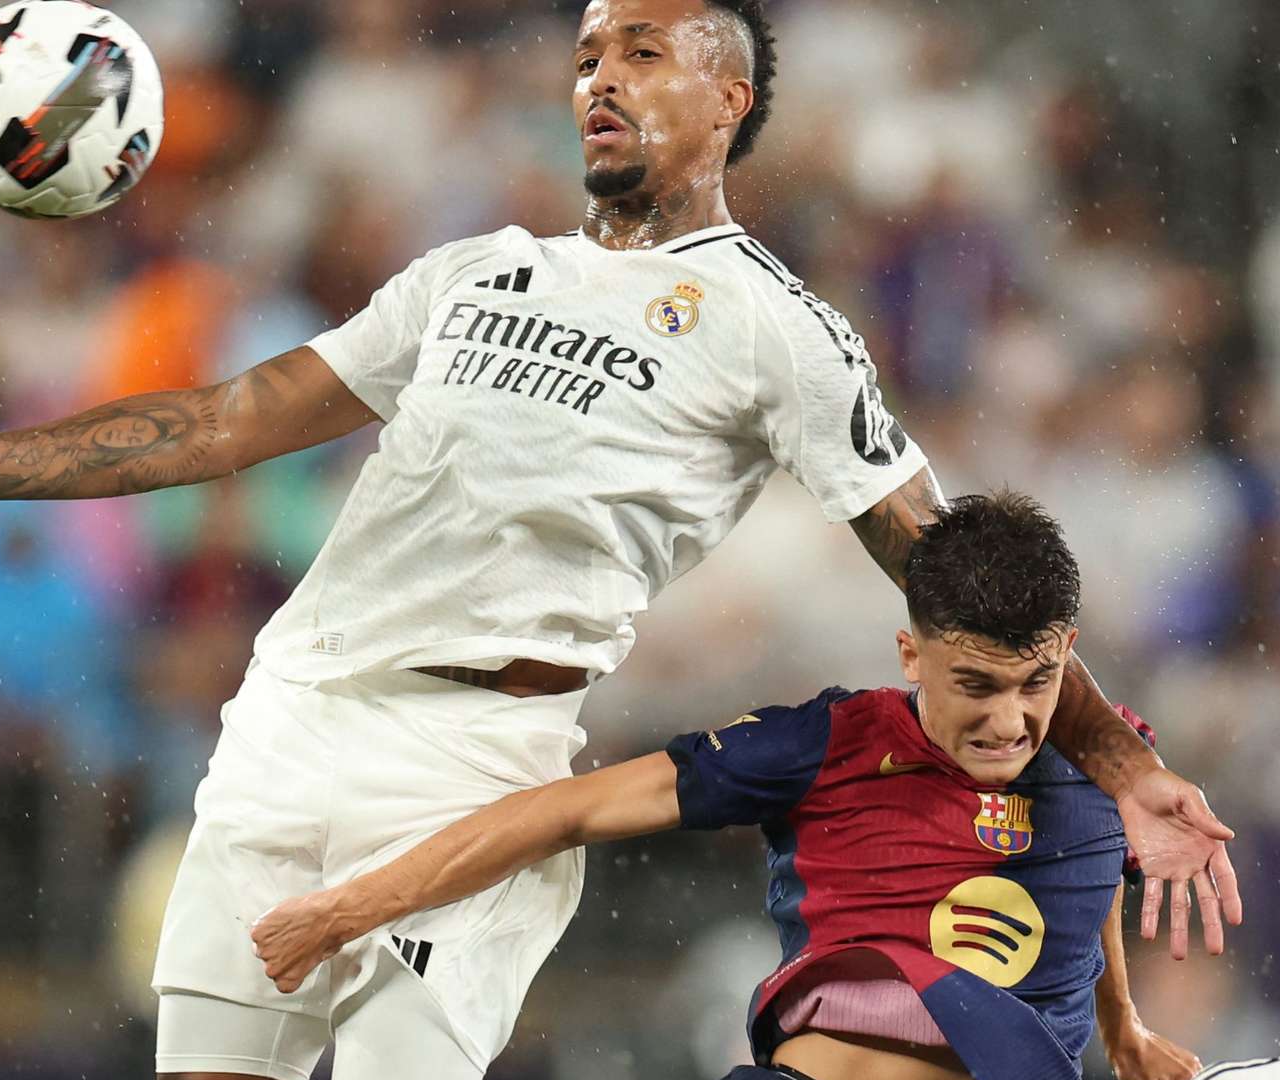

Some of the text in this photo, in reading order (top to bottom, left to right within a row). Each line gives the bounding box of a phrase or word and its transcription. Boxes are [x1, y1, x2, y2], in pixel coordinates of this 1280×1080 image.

[436, 302, 663, 392] Emirates
[443, 348, 606, 416] FLY BETTER
[993, 819, 1015, 829] FCB
